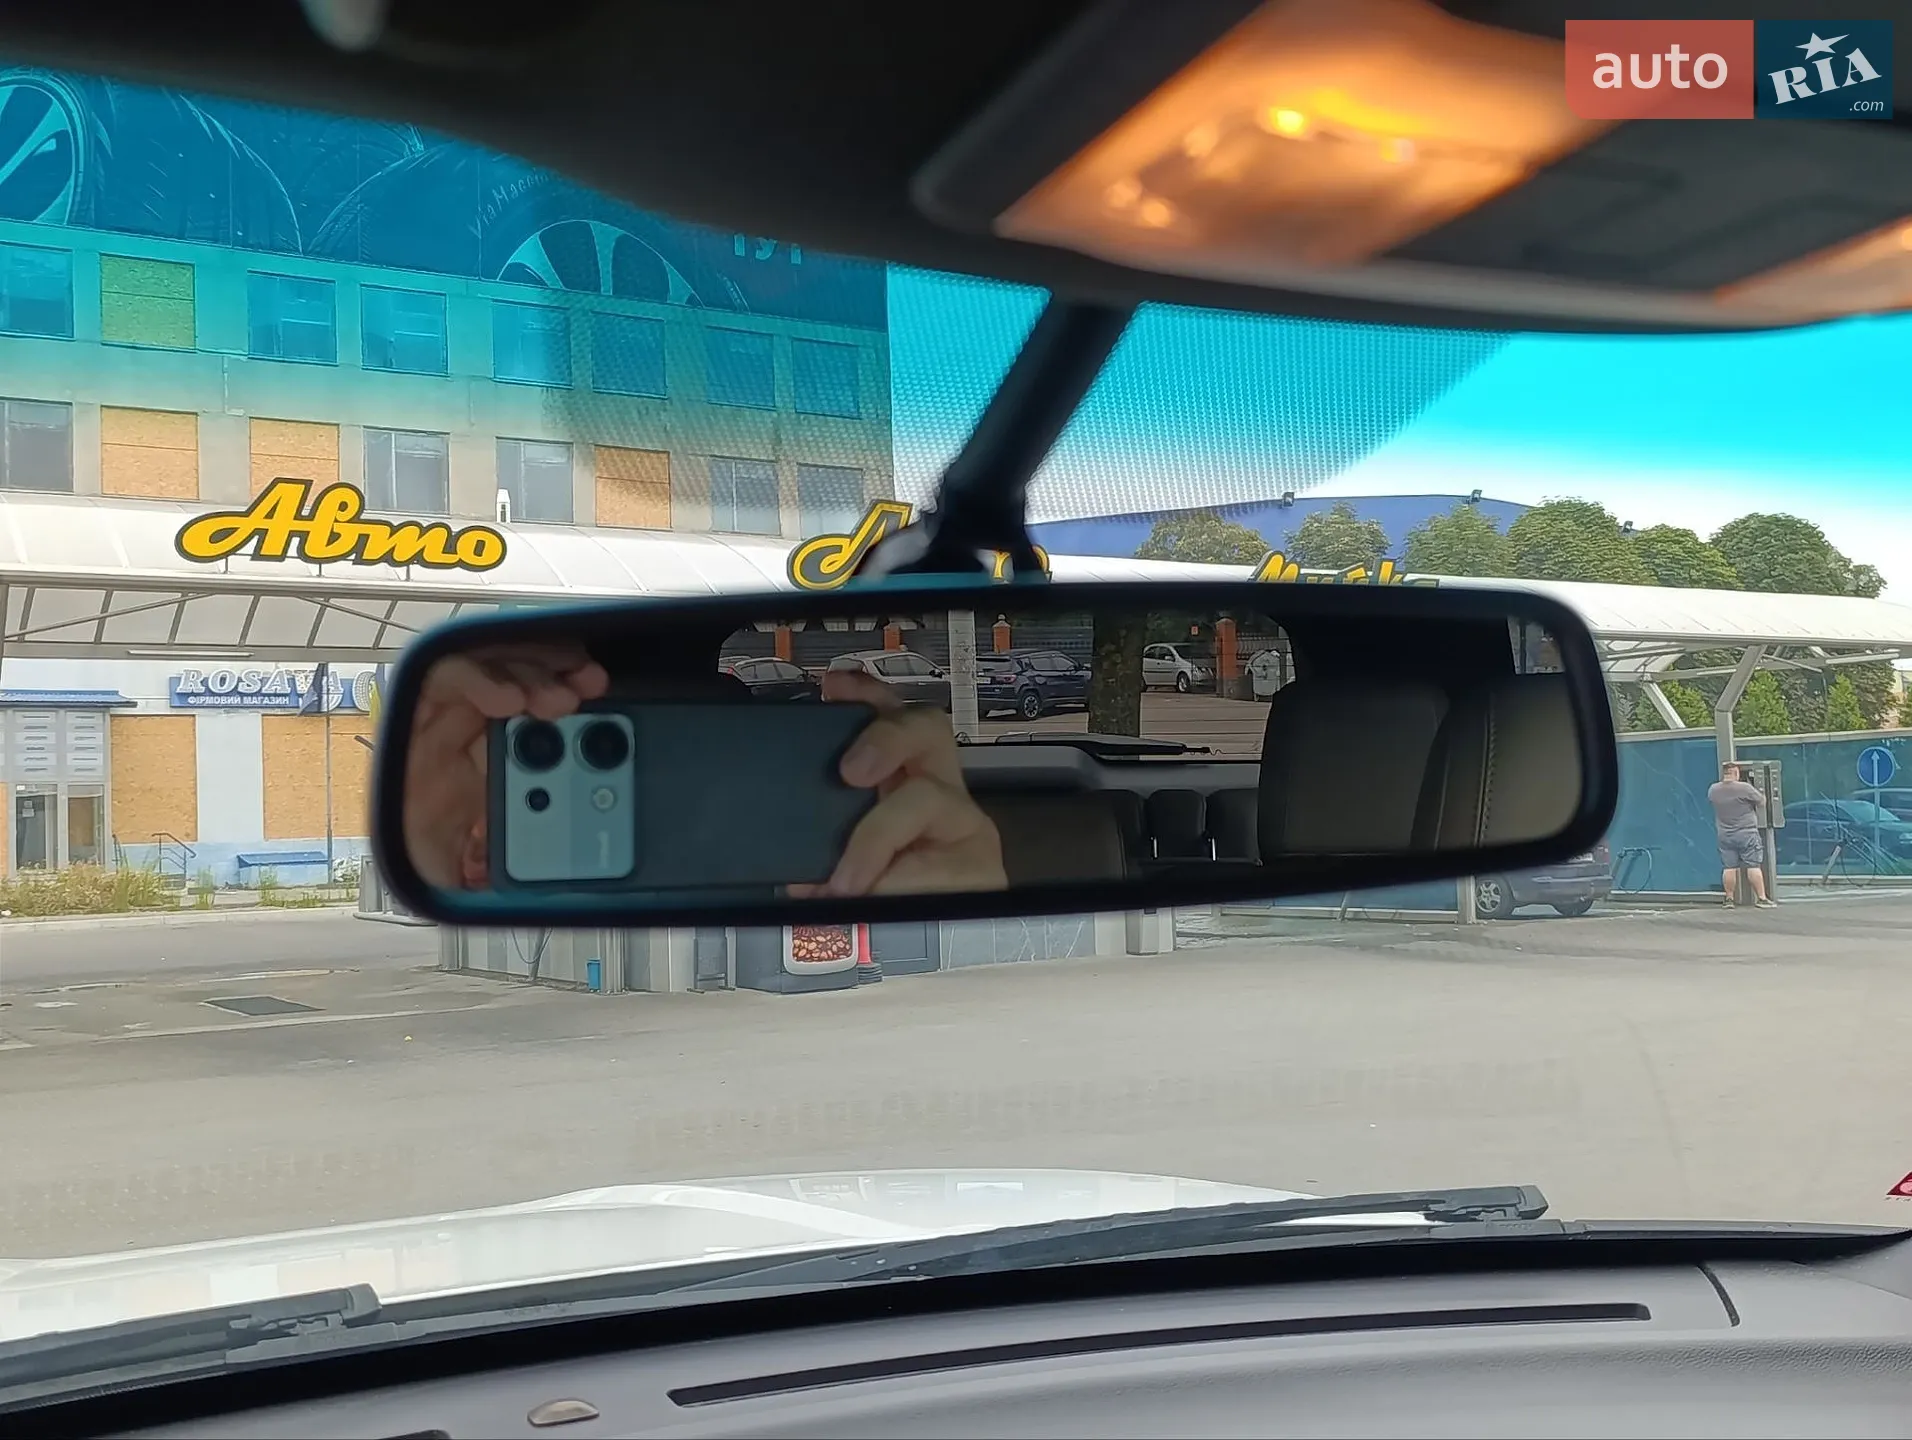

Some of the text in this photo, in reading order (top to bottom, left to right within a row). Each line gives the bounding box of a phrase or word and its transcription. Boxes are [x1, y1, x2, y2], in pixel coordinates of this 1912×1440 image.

[176, 478, 506, 571] Авто
[176, 669, 344, 694] ROSAVA
[187, 694, 290, 705] ФІРМОВИЙ МАГАЗИН
